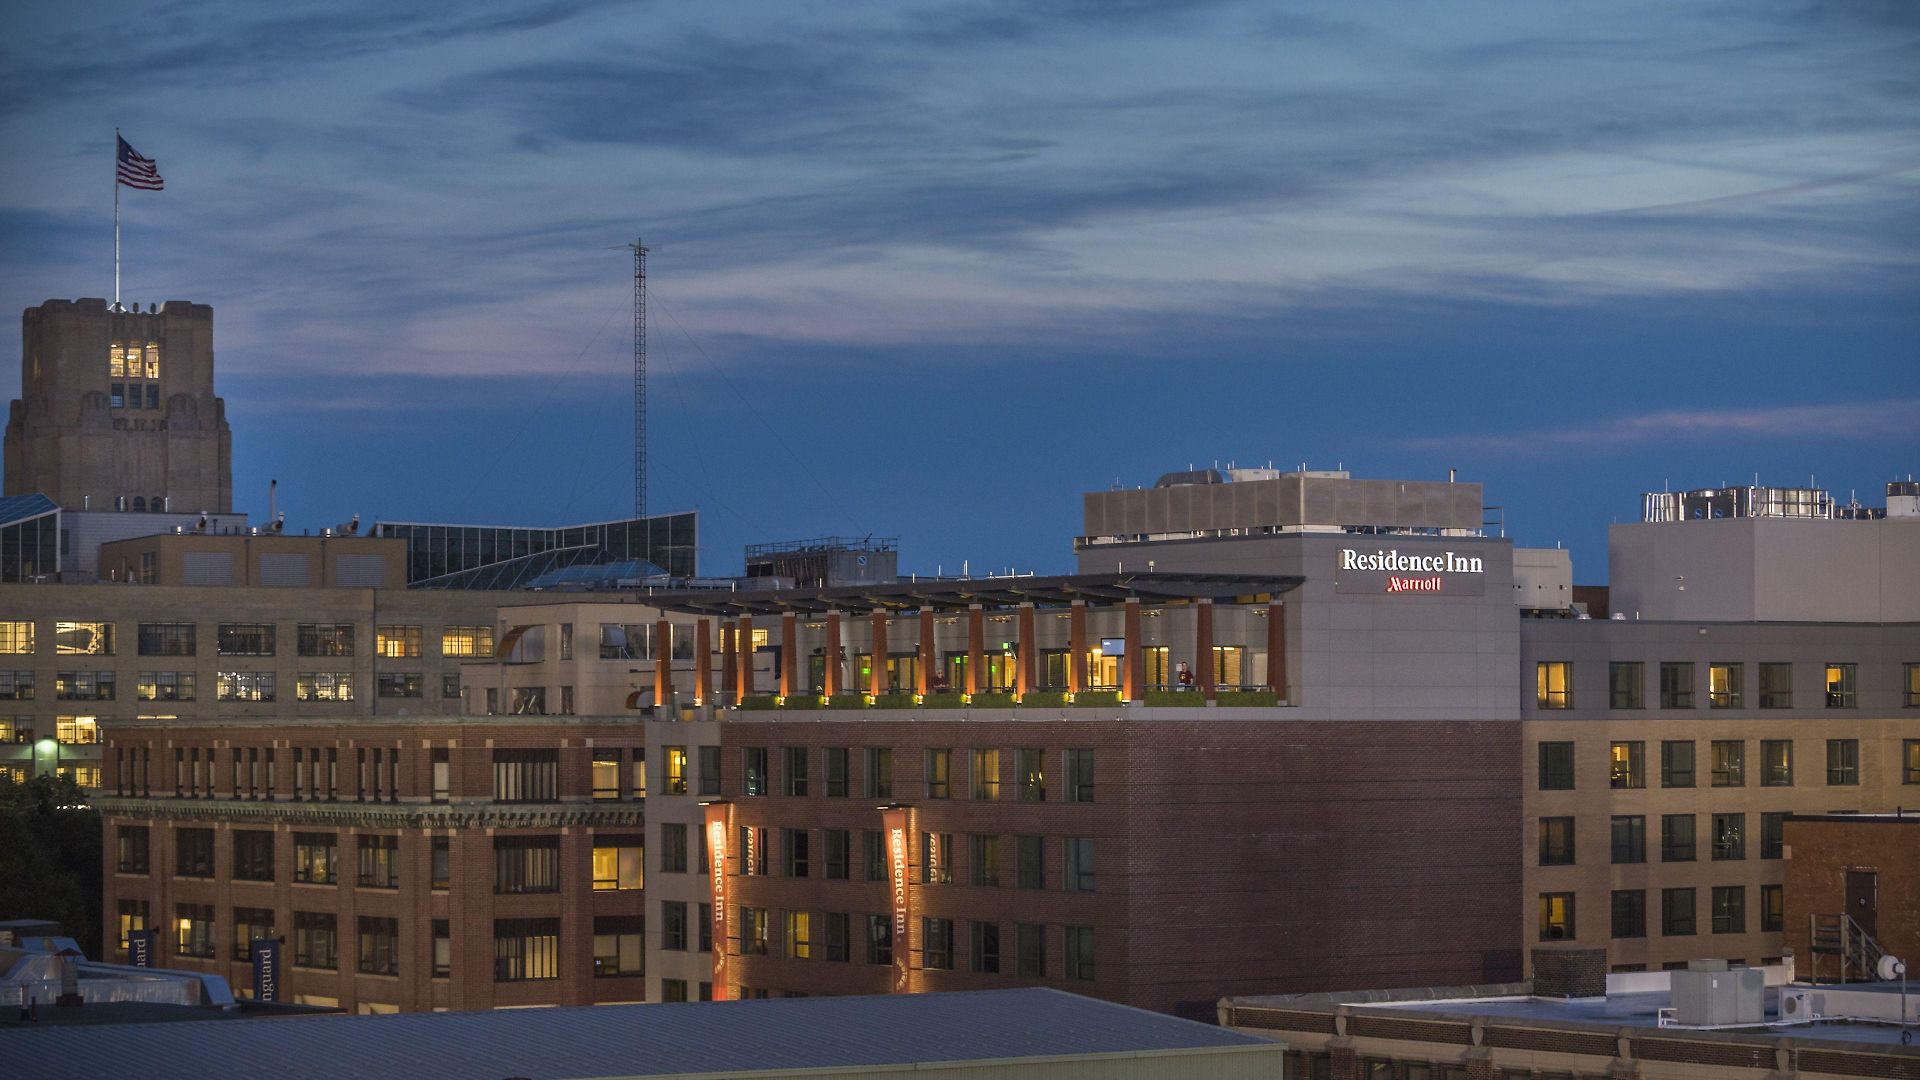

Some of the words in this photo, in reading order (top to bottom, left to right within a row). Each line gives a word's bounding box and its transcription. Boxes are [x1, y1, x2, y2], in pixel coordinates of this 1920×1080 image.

[1342, 549, 1444, 572] Residence
[1445, 551, 1484, 573] Inn
[1387, 576, 1441, 593] Marriott
[712, 821, 724, 893] Residence
[891, 828, 904, 904] Residence
[715, 895, 724, 922] Inn
[896, 906, 907, 935] Inn
